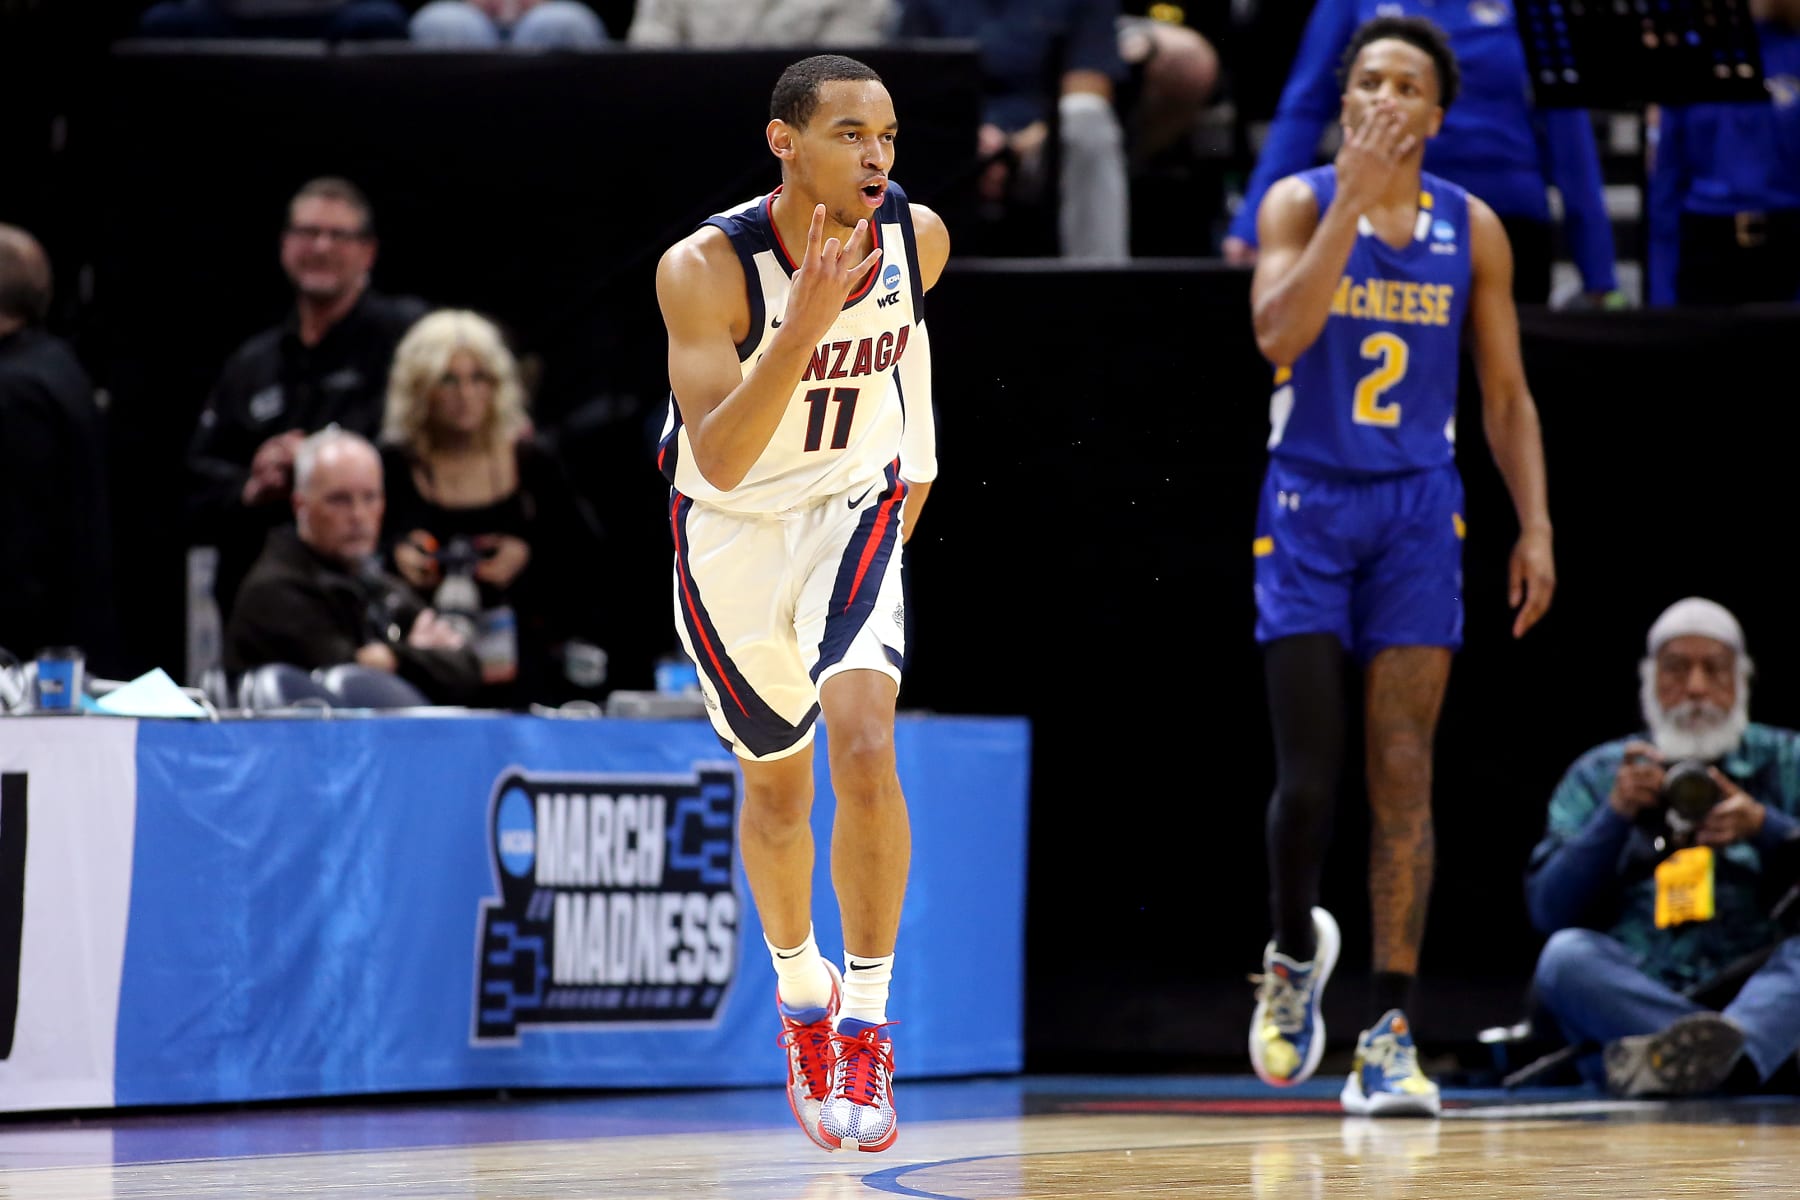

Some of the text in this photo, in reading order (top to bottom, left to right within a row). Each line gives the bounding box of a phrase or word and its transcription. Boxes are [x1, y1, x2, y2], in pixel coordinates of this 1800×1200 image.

[877, 290, 900, 309] WCC
[884, 273, 900, 286] NCAA
[801, 325, 910, 382] NZAGA
[1352, 331, 1410, 428] 2
[803, 386, 860, 453] 11
[535, 794, 667, 886] MARCH
[553, 892, 737, 985] MADNESS
